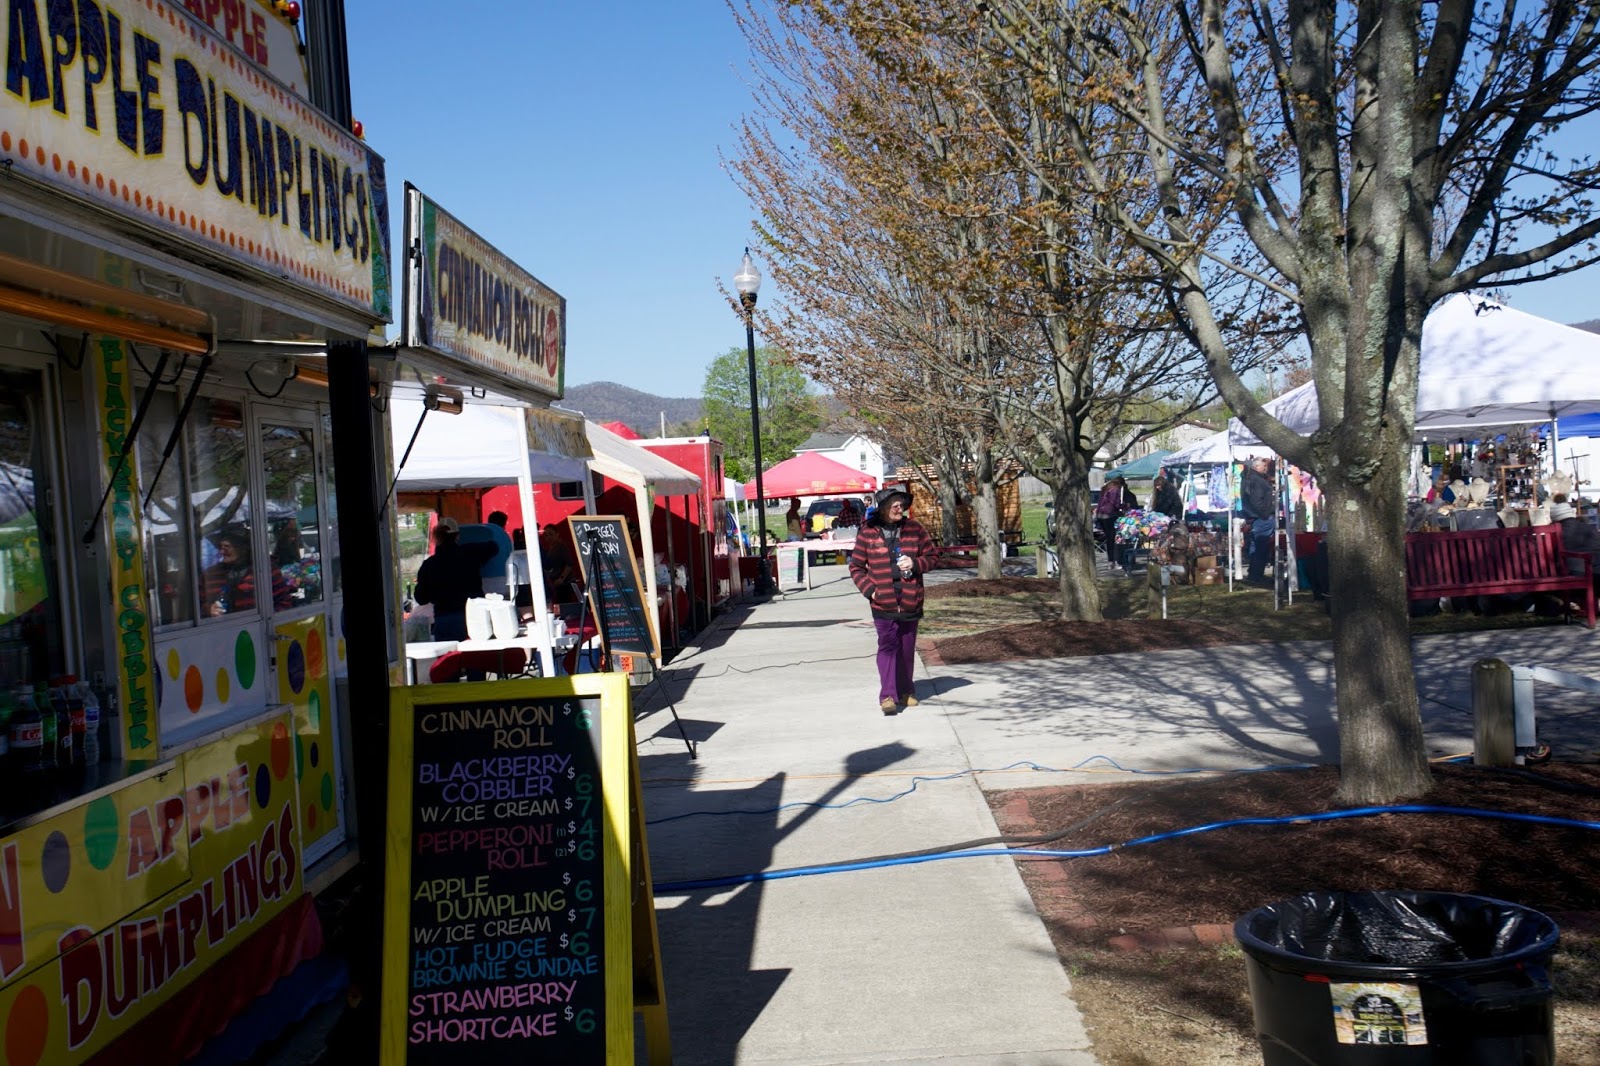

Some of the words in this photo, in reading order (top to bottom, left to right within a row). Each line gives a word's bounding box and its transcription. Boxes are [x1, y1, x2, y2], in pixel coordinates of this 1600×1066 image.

[5, 0, 165, 158] APPLE
[174, 56, 370, 266] DUMPLINGS
[438, 242, 512, 354] CINNAMON
[583, 523, 619, 539] BRGER
[119, 583, 152, 750] COBBLER
[420, 705, 554, 734] CINNAMON
[493, 726, 554, 750] ROLL
[419, 753, 572, 785] BLACKBERRY
[441, 775, 554, 804] COBBLER
[126, 762, 250, 880] APPLE
[493, 798, 560, 819] CREAM
[417, 823, 555, 856] PEPPERONI
[487, 848, 548, 871] ROLL
[413, 875, 490, 904] APPLE
[436, 888, 567, 923] DUMPLING
[56, 799, 297, 1051] DUMPLINGS
[483, 916, 552, 938] CREAM
[414, 945, 460, 969] HOT
[471, 937, 548, 962] FUDGE
[412, 961, 508, 989] BROWNIE
[513, 955, 600, 980] SUNDAE
[408, 979, 578, 1017] STRAWBERRY
[408, 1012, 558, 1045] SHORTCAKE
